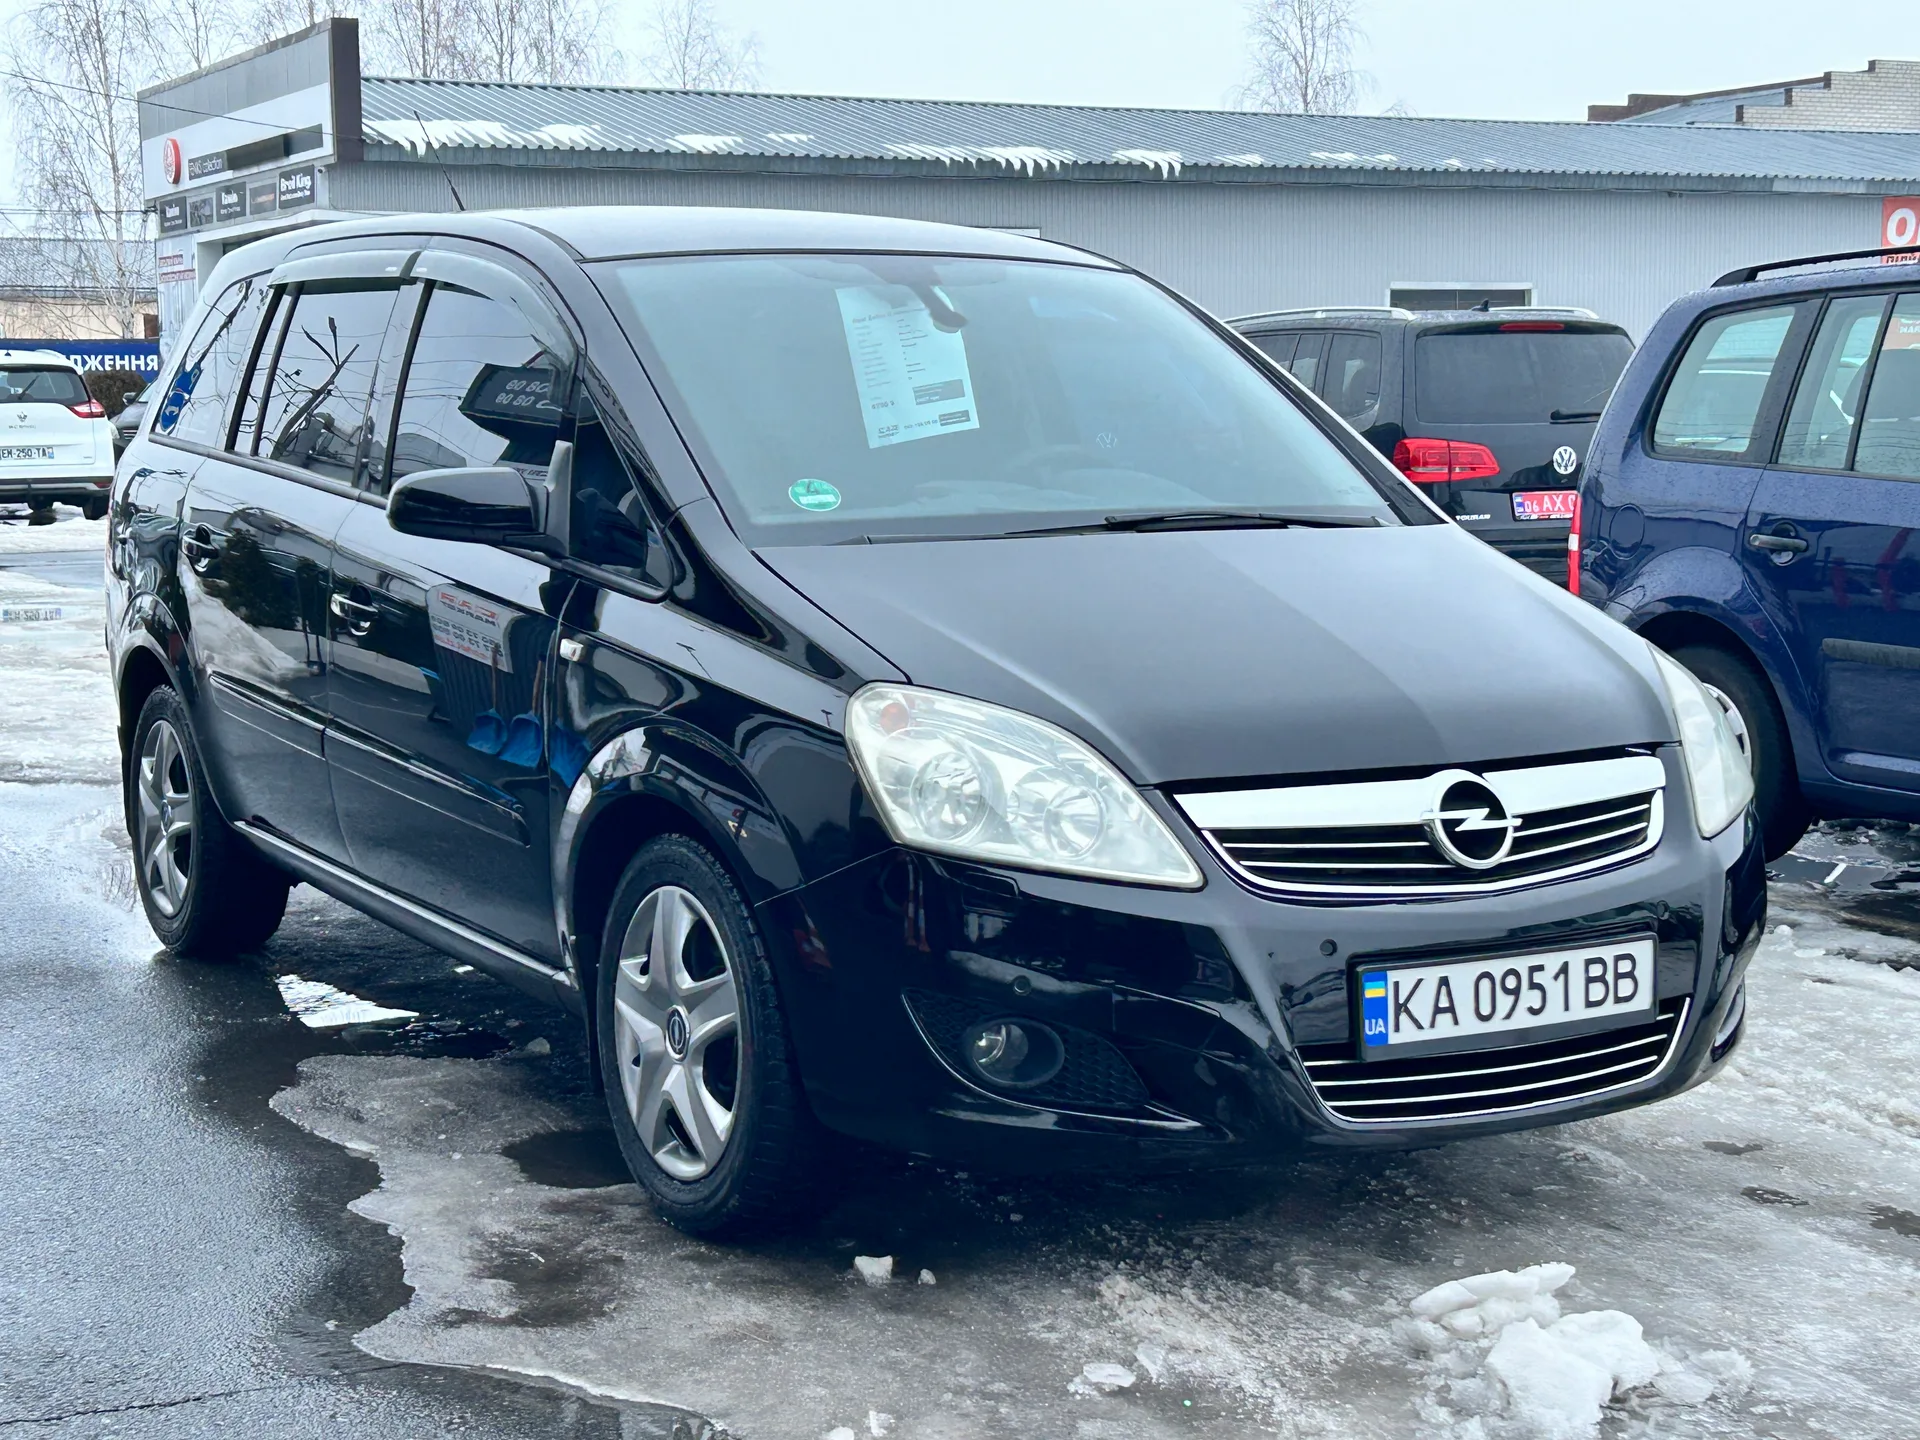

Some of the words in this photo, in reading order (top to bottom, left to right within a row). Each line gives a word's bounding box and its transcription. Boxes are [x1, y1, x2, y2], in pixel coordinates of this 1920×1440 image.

[65, 354, 159, 371] ДЖЕННЯ
[1542, 494, 1565, 512] AX
[1393, 975, 1460, 1033] KA
[1474, 960, 1570, 1022] 0951
[1584, 952, 1640, 1009] BB
[1364, 1017, 1386, 1036] UA
